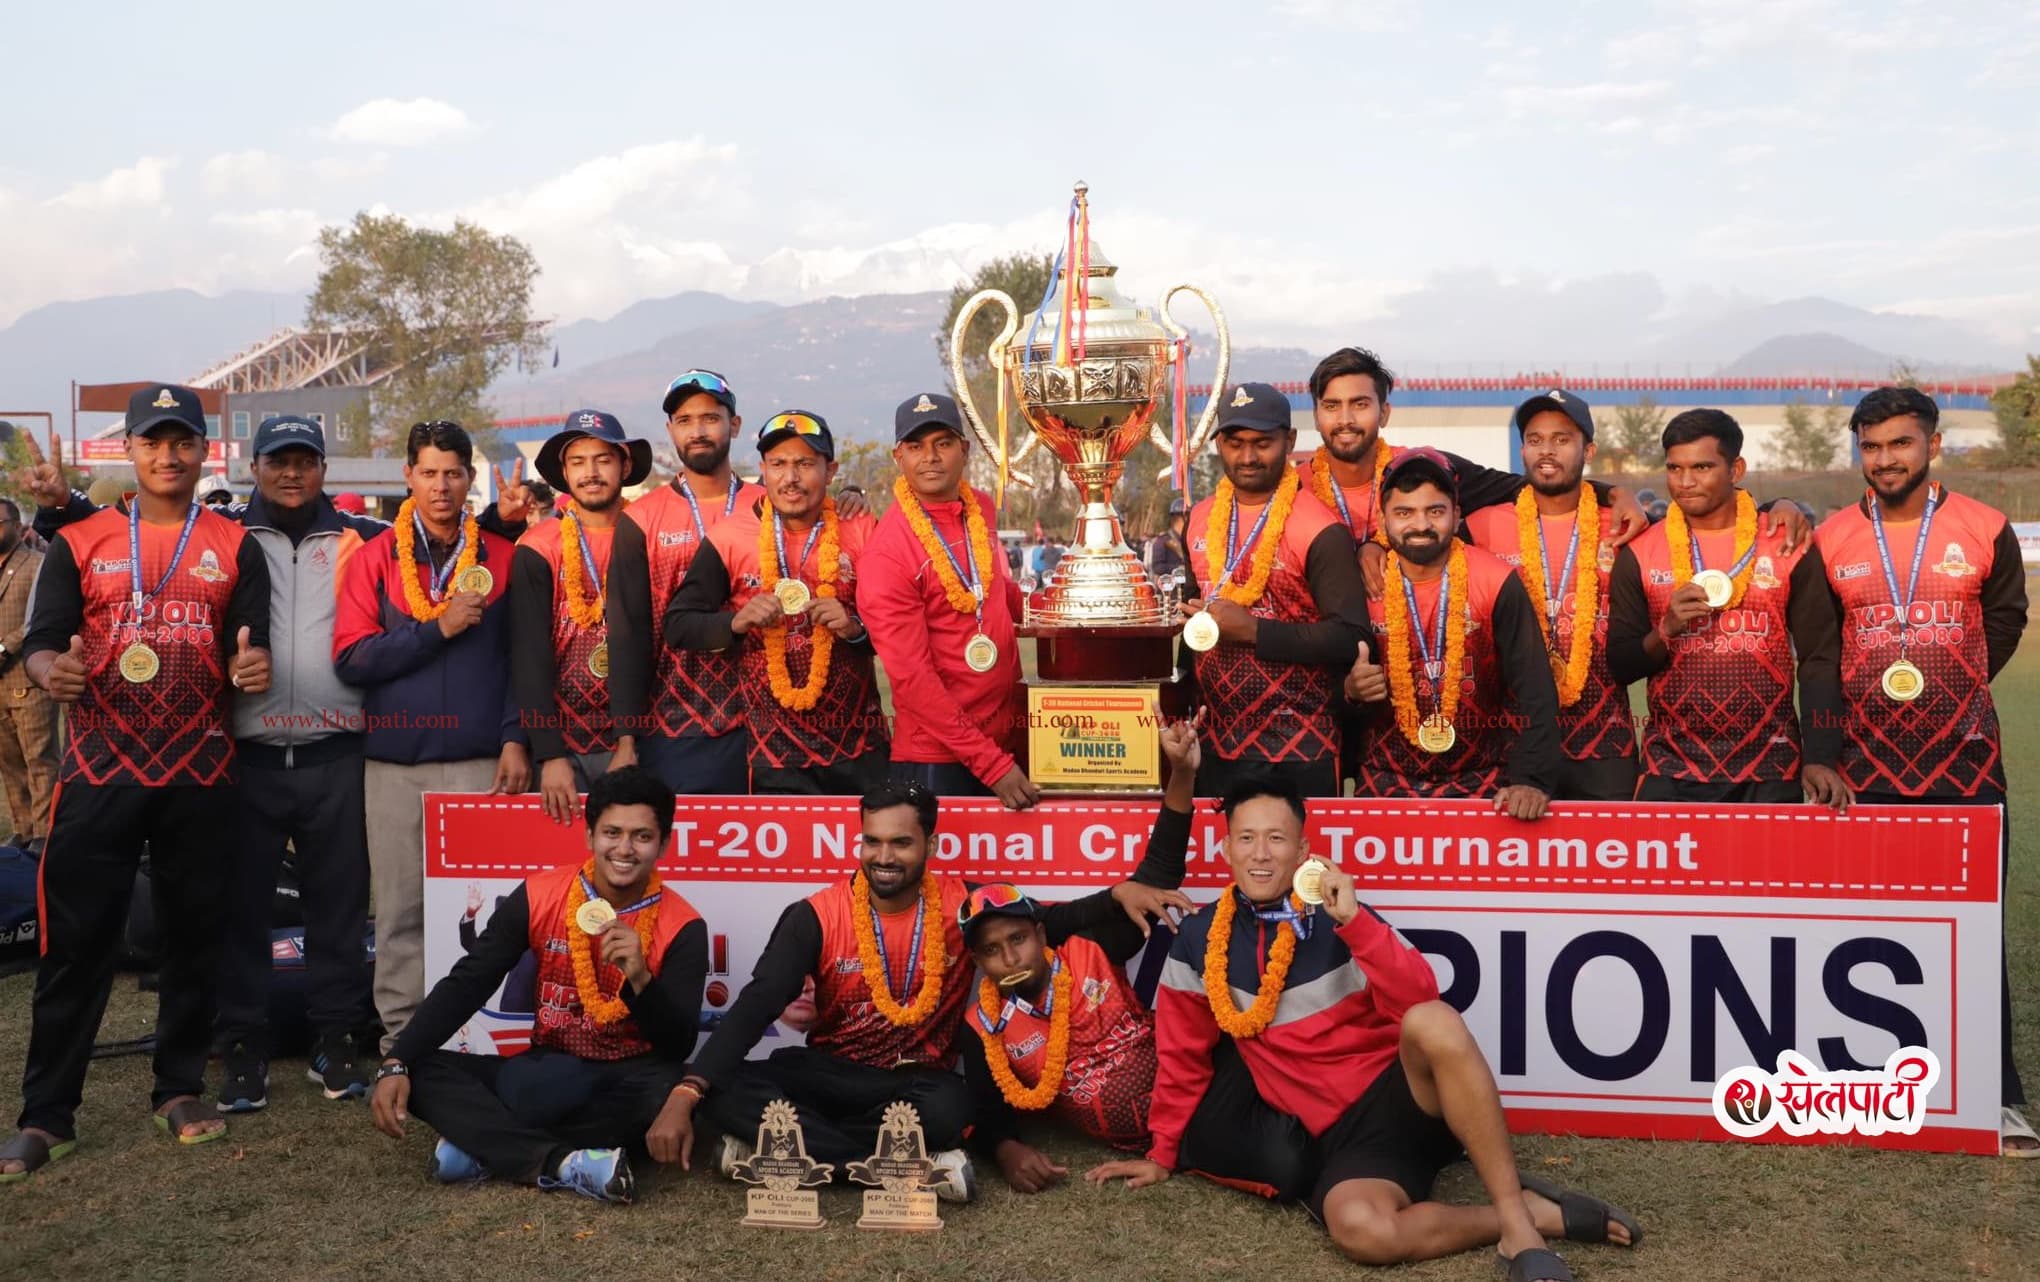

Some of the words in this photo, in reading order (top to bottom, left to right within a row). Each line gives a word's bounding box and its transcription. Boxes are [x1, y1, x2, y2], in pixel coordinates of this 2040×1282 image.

[162, 599, 213, 628] OLI
[1719, 609, 1769, 637] OLI
[1852, 603, 1898, 632] KP
[1908, 600, 1963, 627] OLI
[1855, 626, 1964, 649] CUP-2080
[1060, 742, 1126, 758] WINNER
[672, 821, 787, 858] T-20
[1320, 826, 1698, 870] Tournament
[541, 982, 582, 1011] KP
[767, 1193, 784, 1201] OLI
[884, 1194, 902, 1202] OLI
